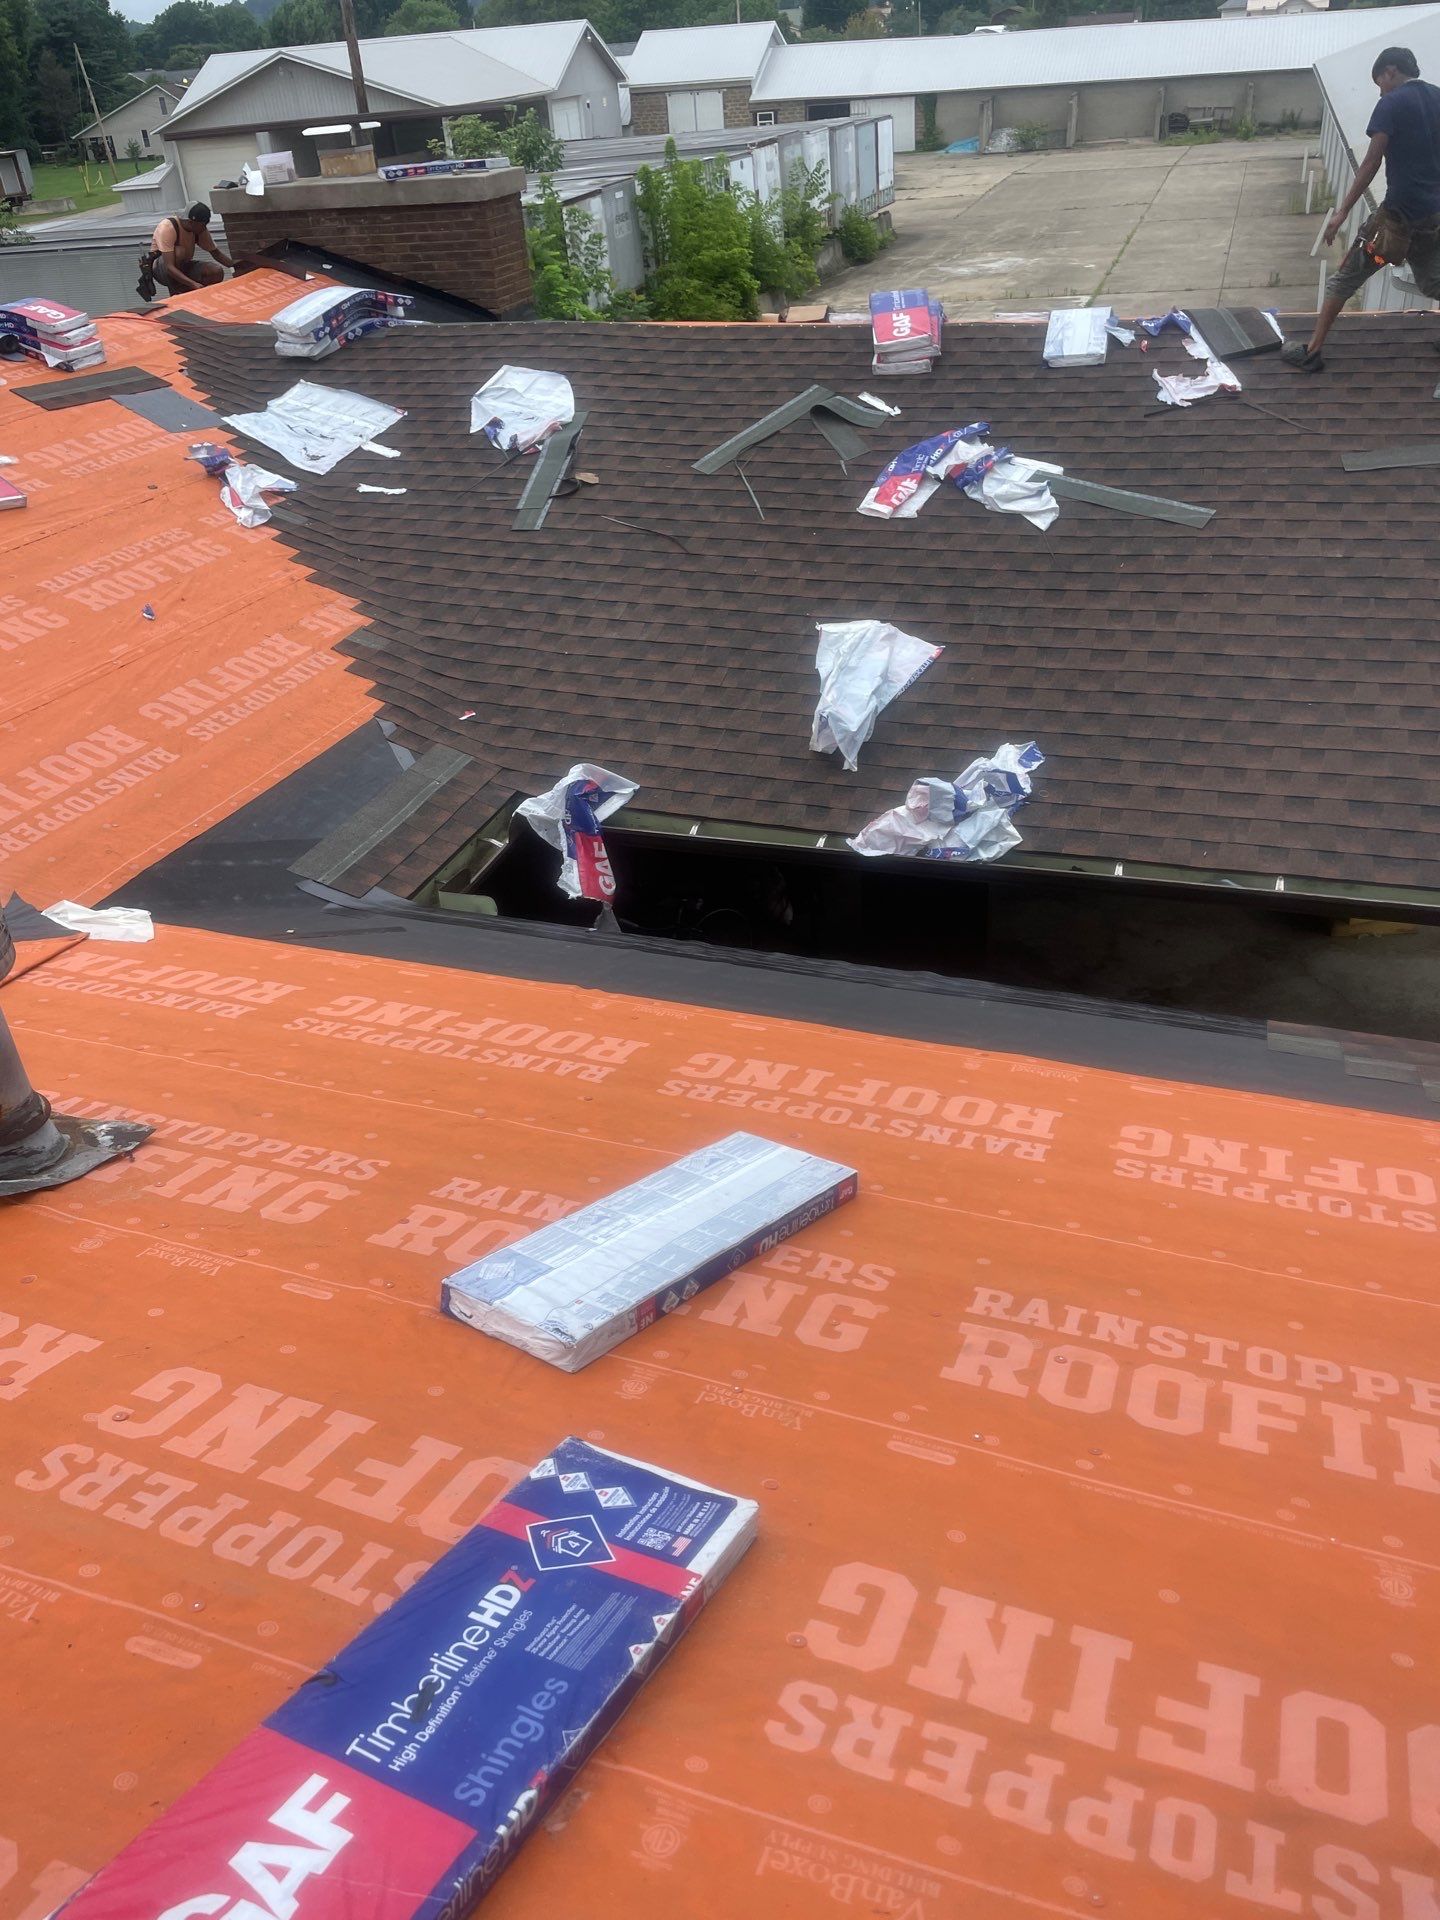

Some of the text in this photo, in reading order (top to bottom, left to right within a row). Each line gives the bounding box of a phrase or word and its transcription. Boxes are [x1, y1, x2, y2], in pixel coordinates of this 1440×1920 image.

[23, 305, 66, 320] GAF
[892, 312, 912, 337] GAF
[890, 477, 918, 506] GAF
[38, 528, 193, 592] RAINSTOPPERS
[64, 538, 232, 612] ROOFING
[138, 633, 312, 730] ROOFING
[186, 651, 339, 742] RAINSTOPPERS
[593, 841, 617, 896] GAF
[283, 1017, 617, 1084] RAINSTOPPERS
[315, 995, 651, 1064] ROOFING
[657, 1079, 1052, 1163] RAINSTOPPERS
[677, 1051, 1064, 1140] ROOFING
[388, 1740, 421, 1772] High
[493, 1609, 534, 1649] Shingles
[454, 1676, 569, 1808] Shingles
